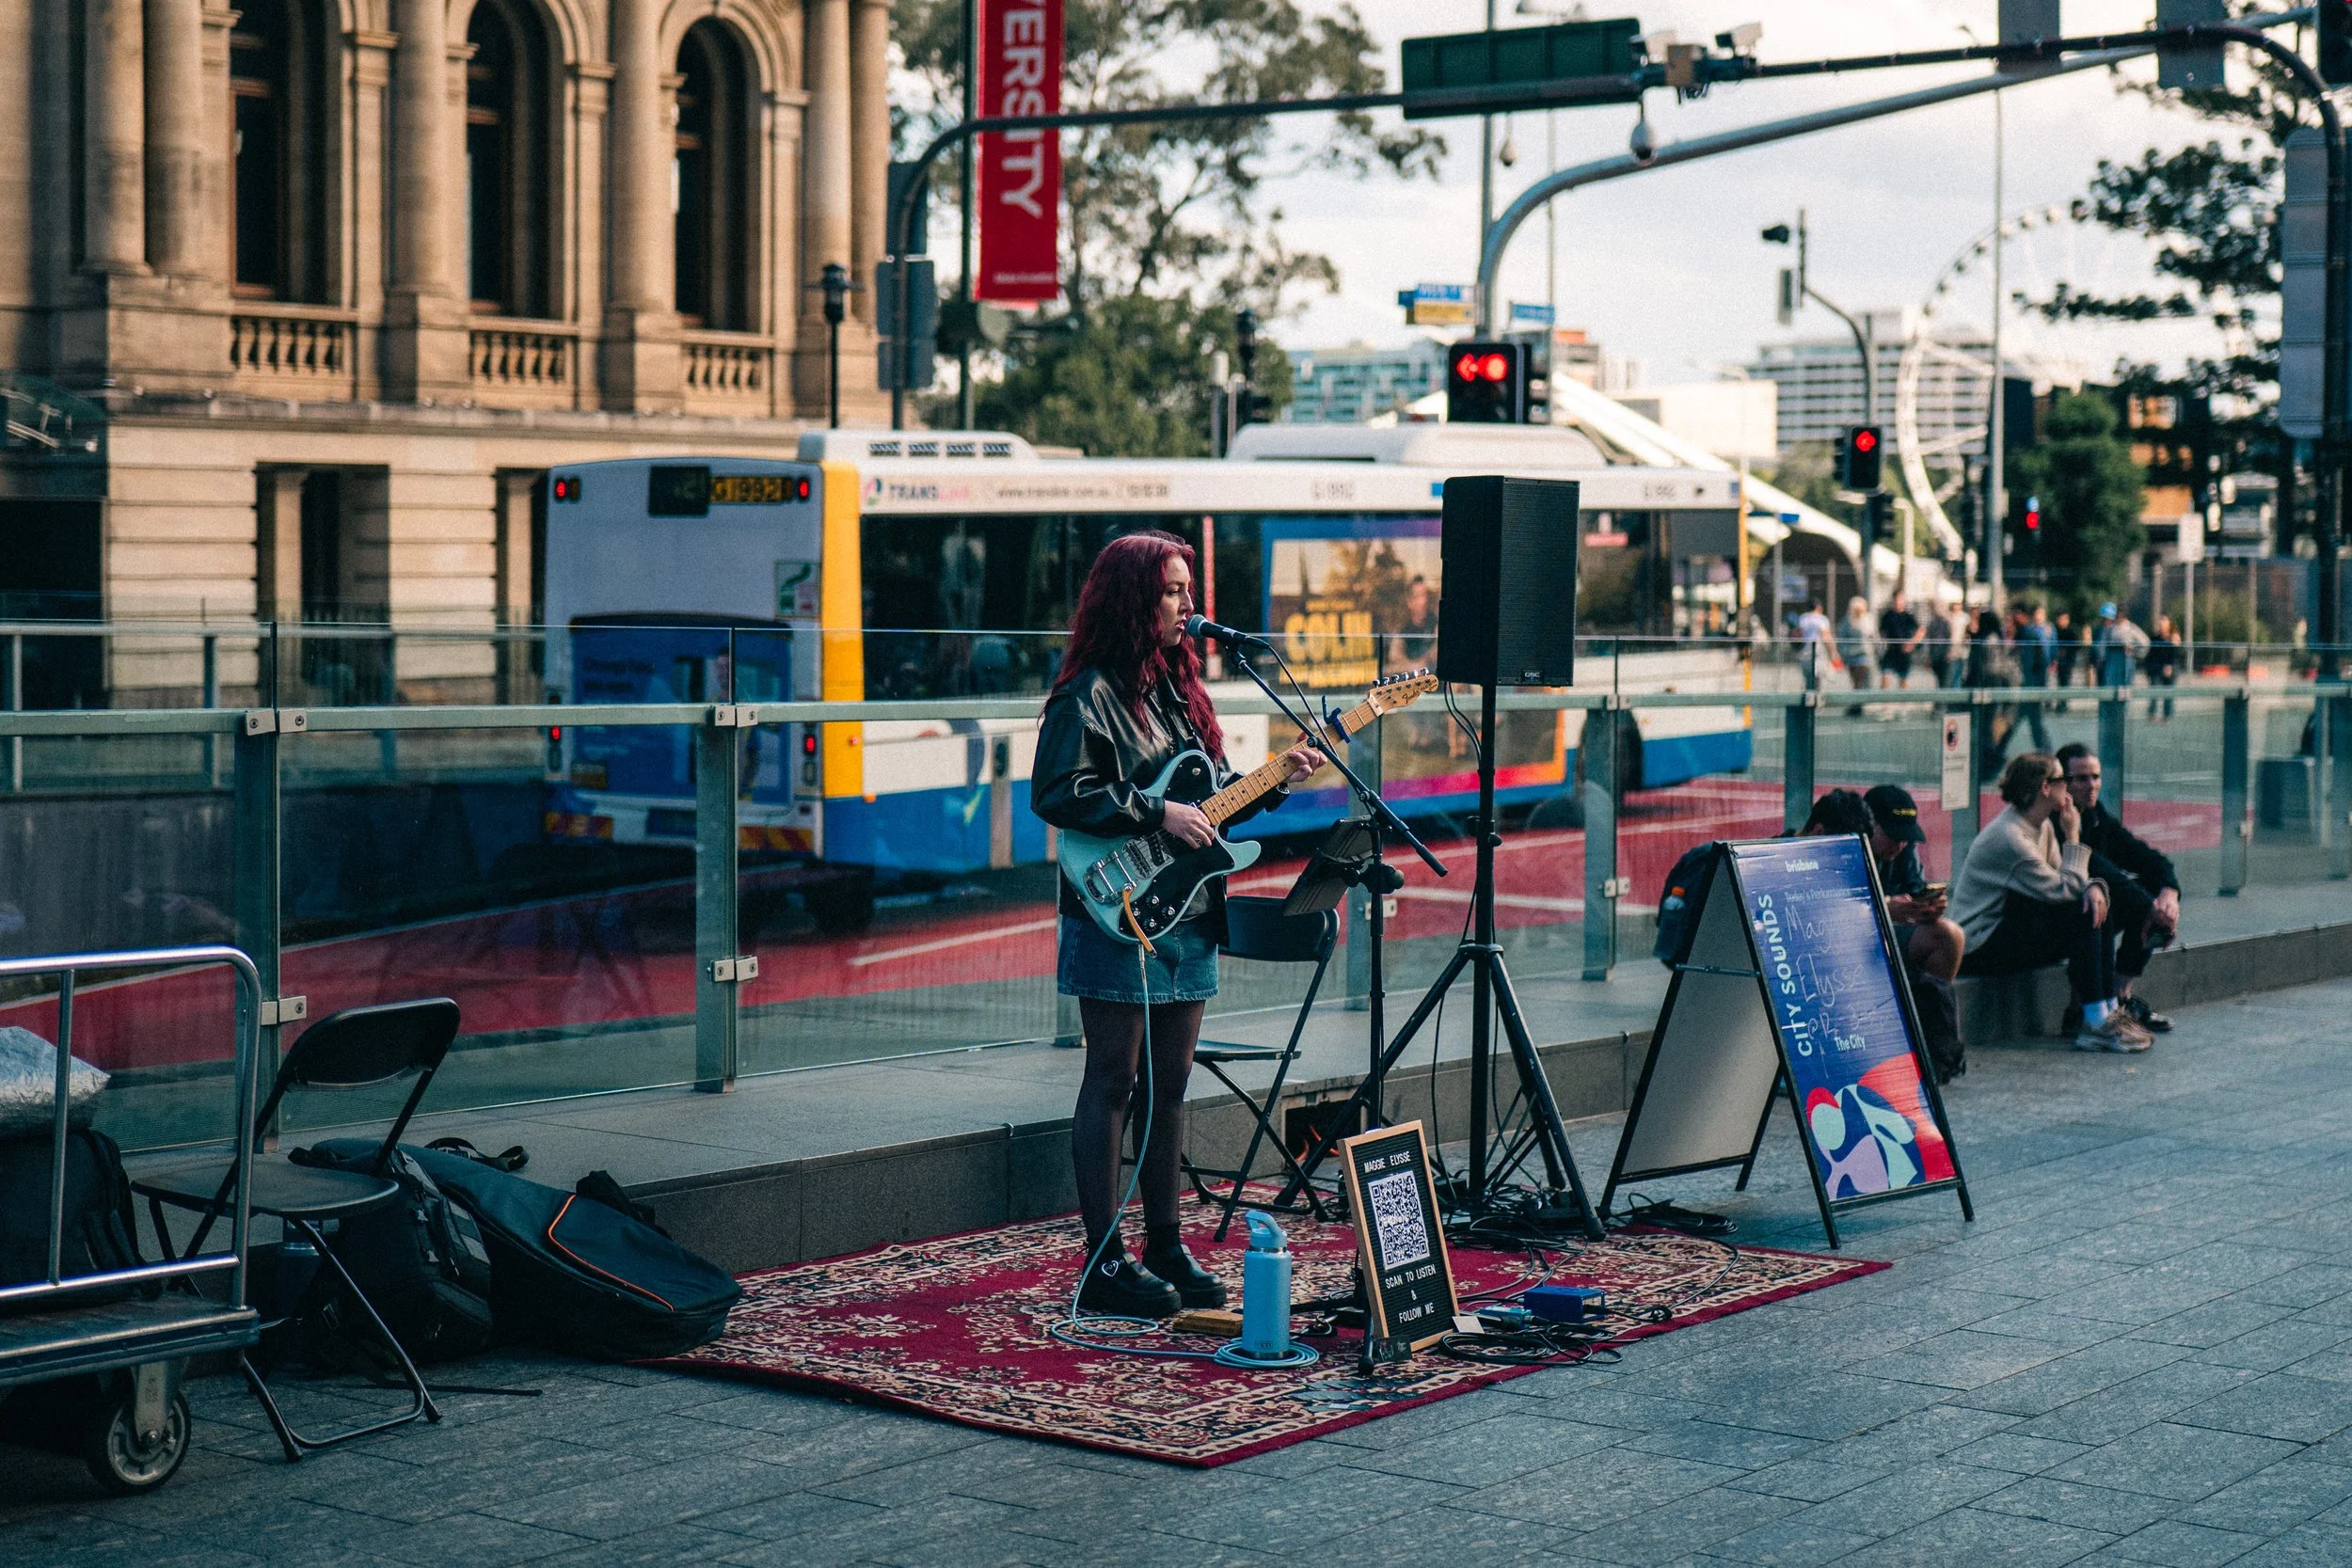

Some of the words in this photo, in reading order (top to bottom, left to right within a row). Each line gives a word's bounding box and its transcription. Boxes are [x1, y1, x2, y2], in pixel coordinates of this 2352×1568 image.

[1000, 0, 1046, 219] ERSITY
[1757, 894, 1797, 995] SOUNDS
[1835, 1036, 1851, 1052] The
[1849, 1033, 1866, 1052] City
[1363, 1158, 1386, 1174] MAGGIE
[1390, 1150, 1411, 1166] ELYSSE
[1385, 1274, 1403, 1289] SCAN
[1405, 1271, 1414, 1283] TO
[1416, 1263, 1437, 1279] LISTEN
[1410, 1290, 1417, 1300] &
[1398, 1306, 1422, 1324] FOLLOW
[1424, 1302, 1435, 1315] ME
